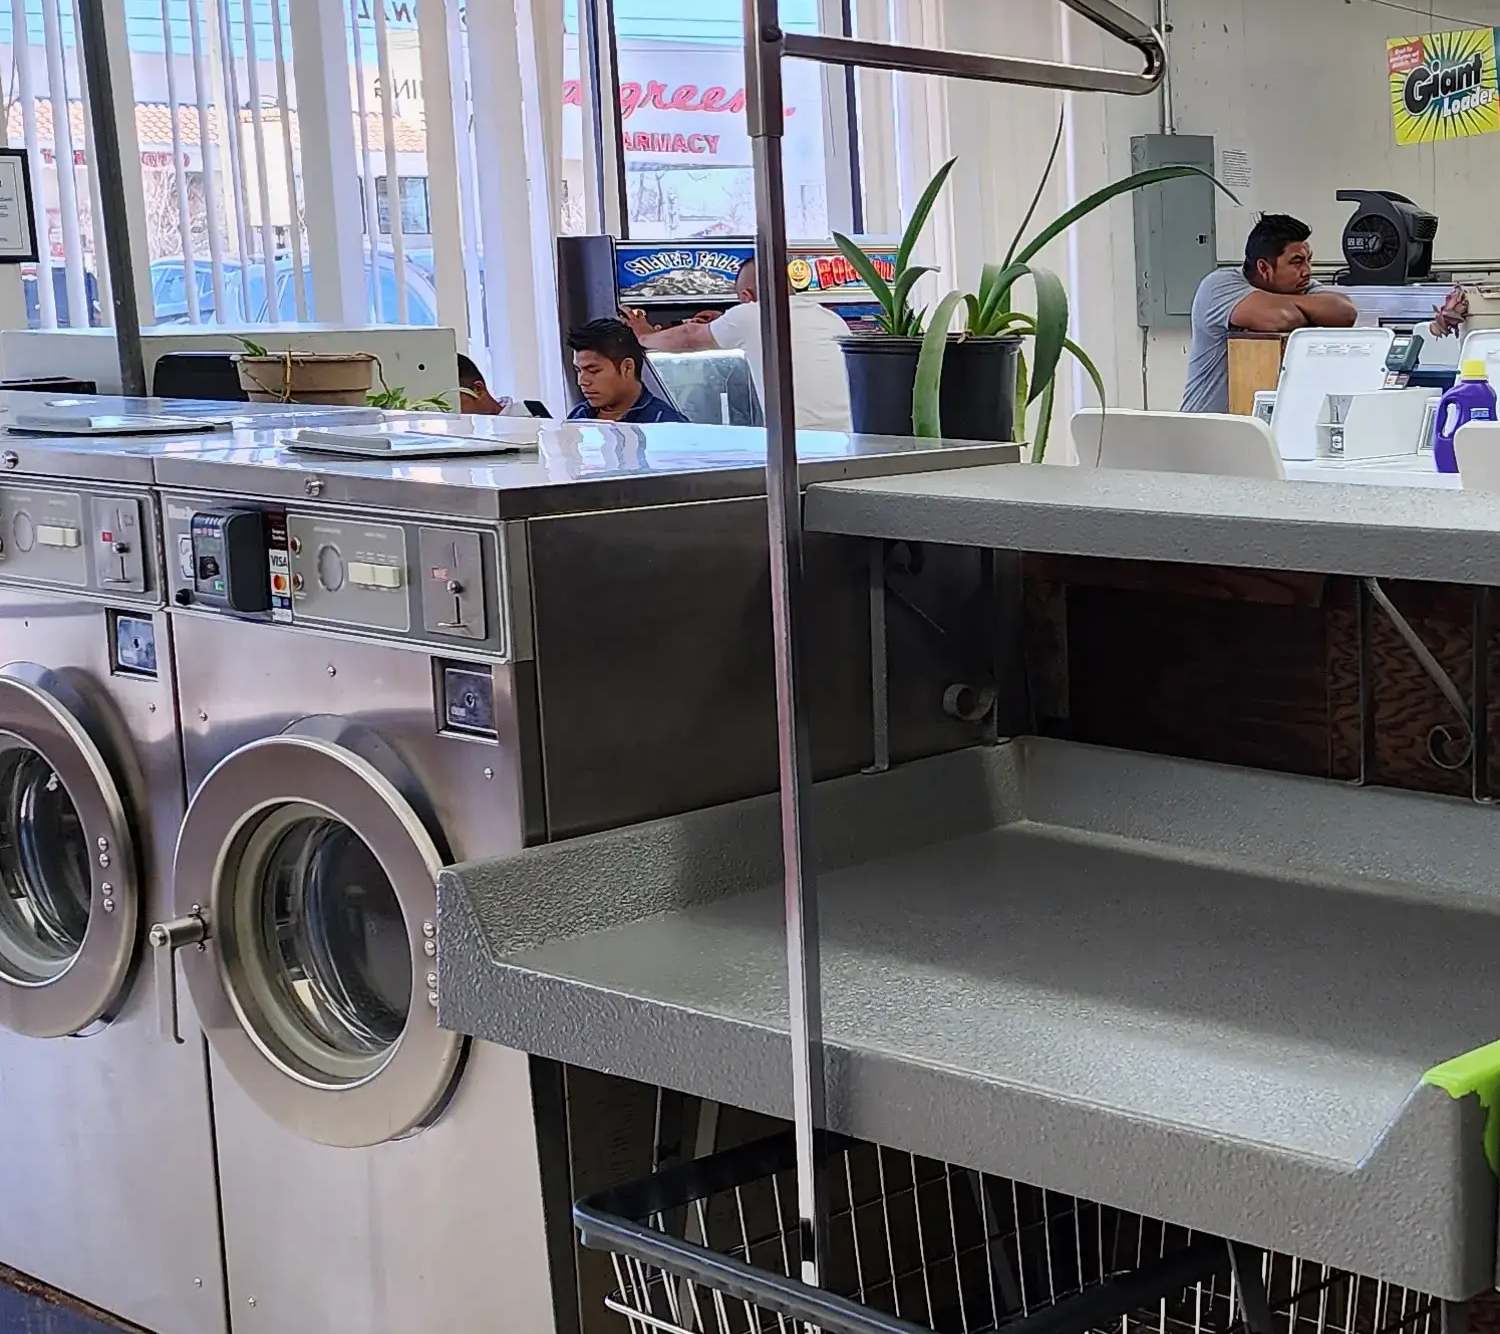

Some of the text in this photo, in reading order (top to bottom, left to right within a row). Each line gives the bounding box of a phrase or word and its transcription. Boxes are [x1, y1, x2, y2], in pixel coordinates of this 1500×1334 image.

[1403, 50, 1484, 116] Giant
[1443, 87, 1495, 117] Loader
[621, 131, 720, 154] ARMACY
[624, 250, 693, 277] SILVER
[271, 555, 287, 568] VISA
